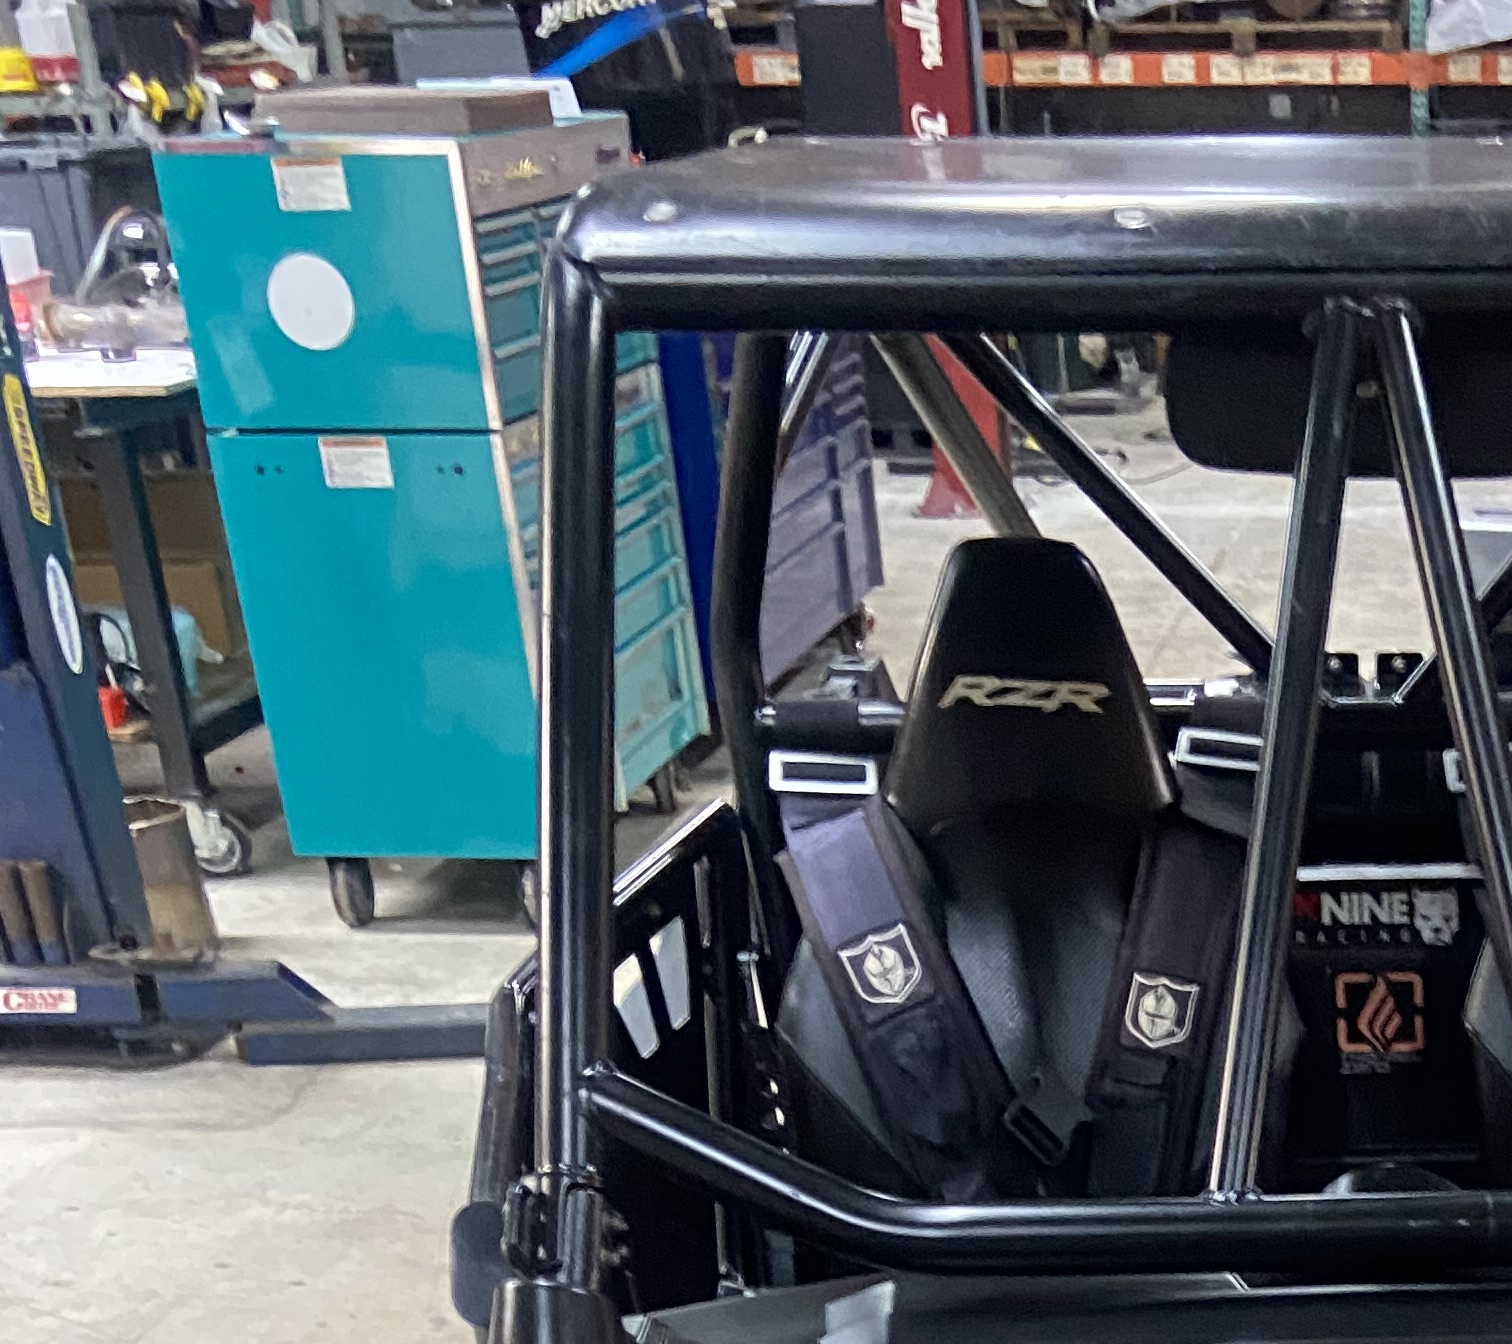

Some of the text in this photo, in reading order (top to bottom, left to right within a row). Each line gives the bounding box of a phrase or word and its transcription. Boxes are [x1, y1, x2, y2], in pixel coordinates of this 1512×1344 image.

[535, 0, 657, 39] MERC
[937, 675, 1112, 714] RZR
[1320, 891, 1411, 926] NINE
